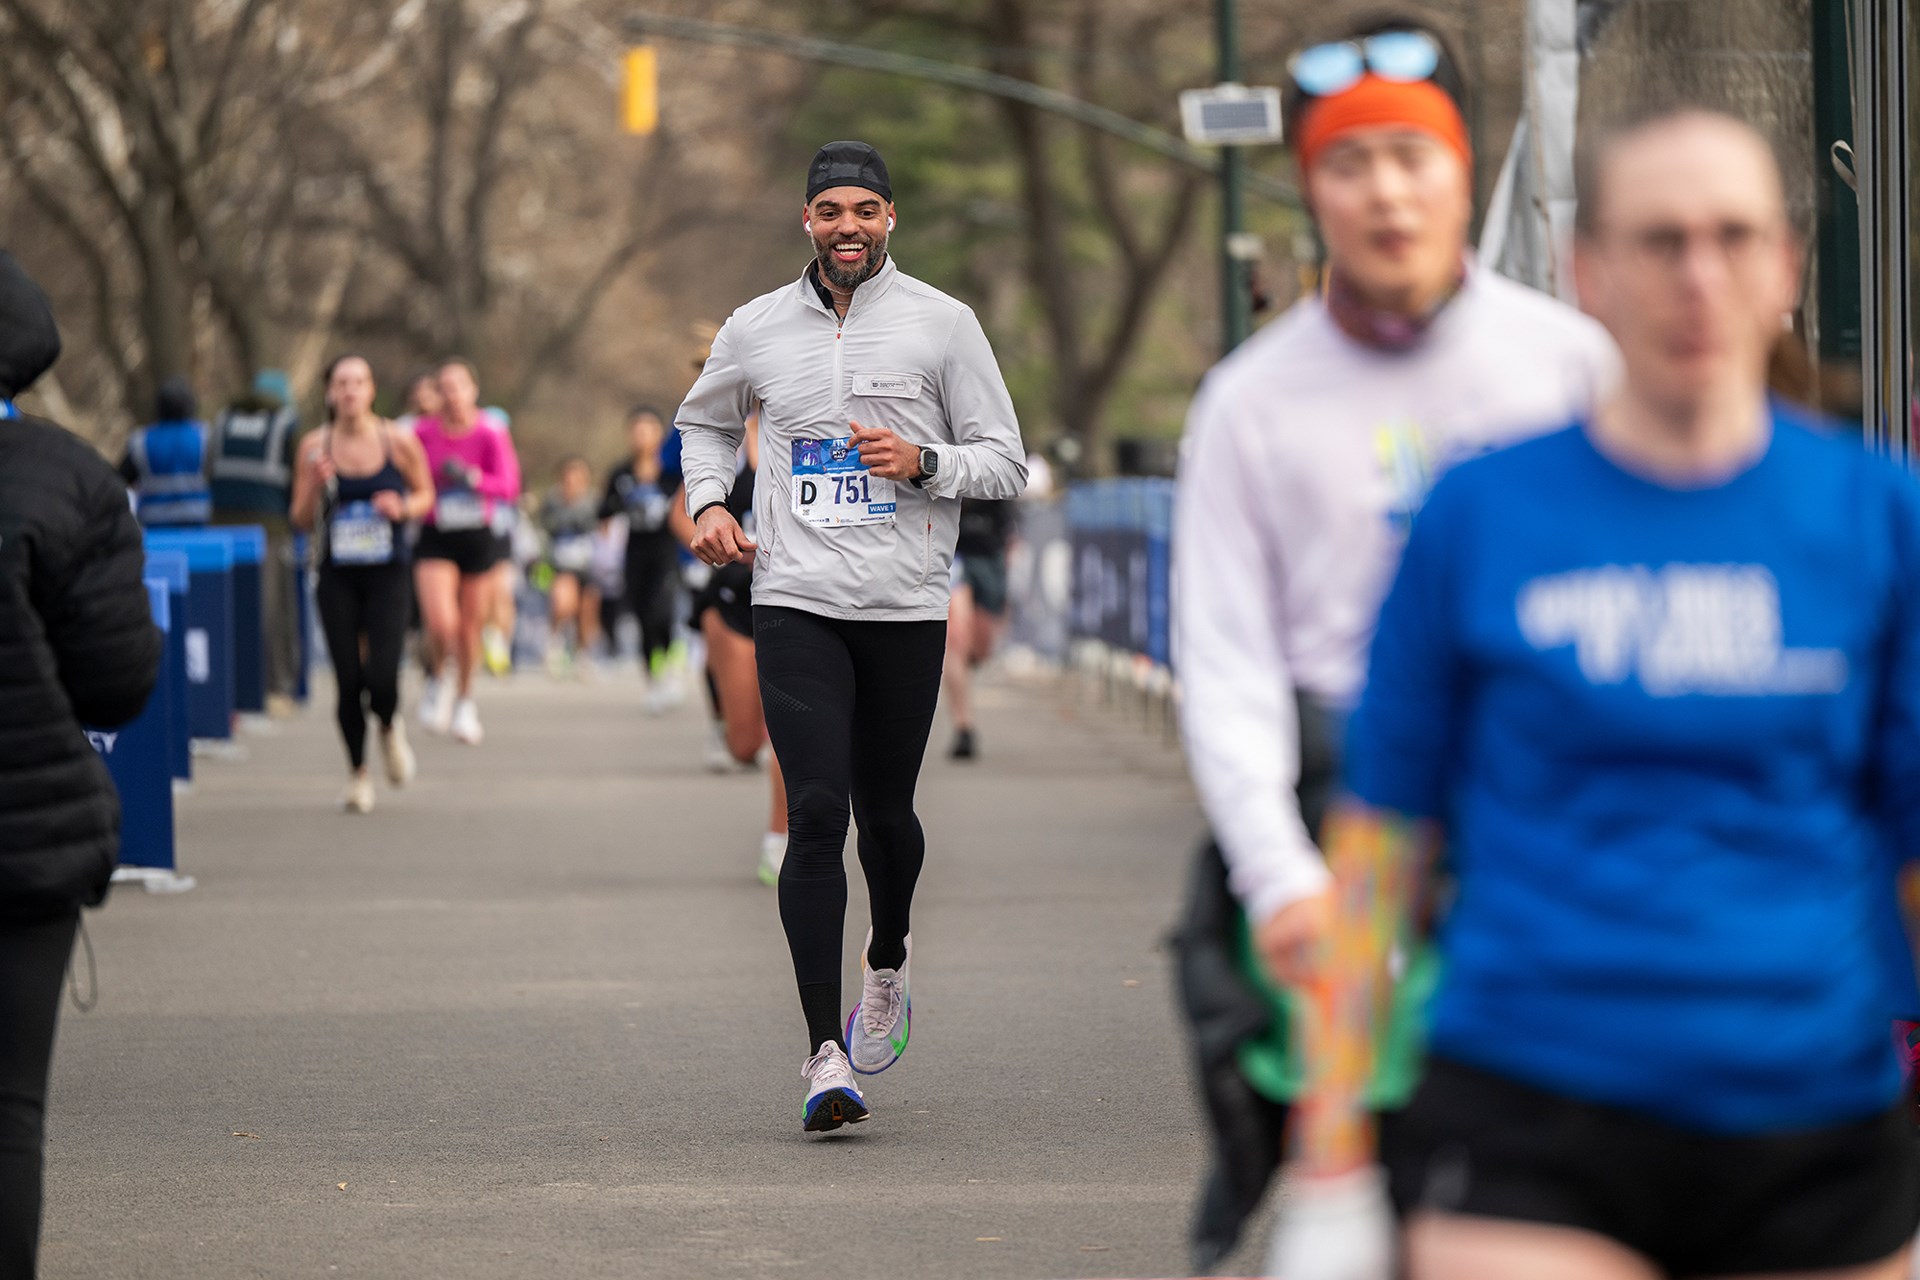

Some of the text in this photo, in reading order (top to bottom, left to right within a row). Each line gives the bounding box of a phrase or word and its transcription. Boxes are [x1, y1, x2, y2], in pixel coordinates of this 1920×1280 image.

[801, 480, 817, 505] D
[831, 474, 872, 504] 751
[869, 504, 889, 513] WAVE
